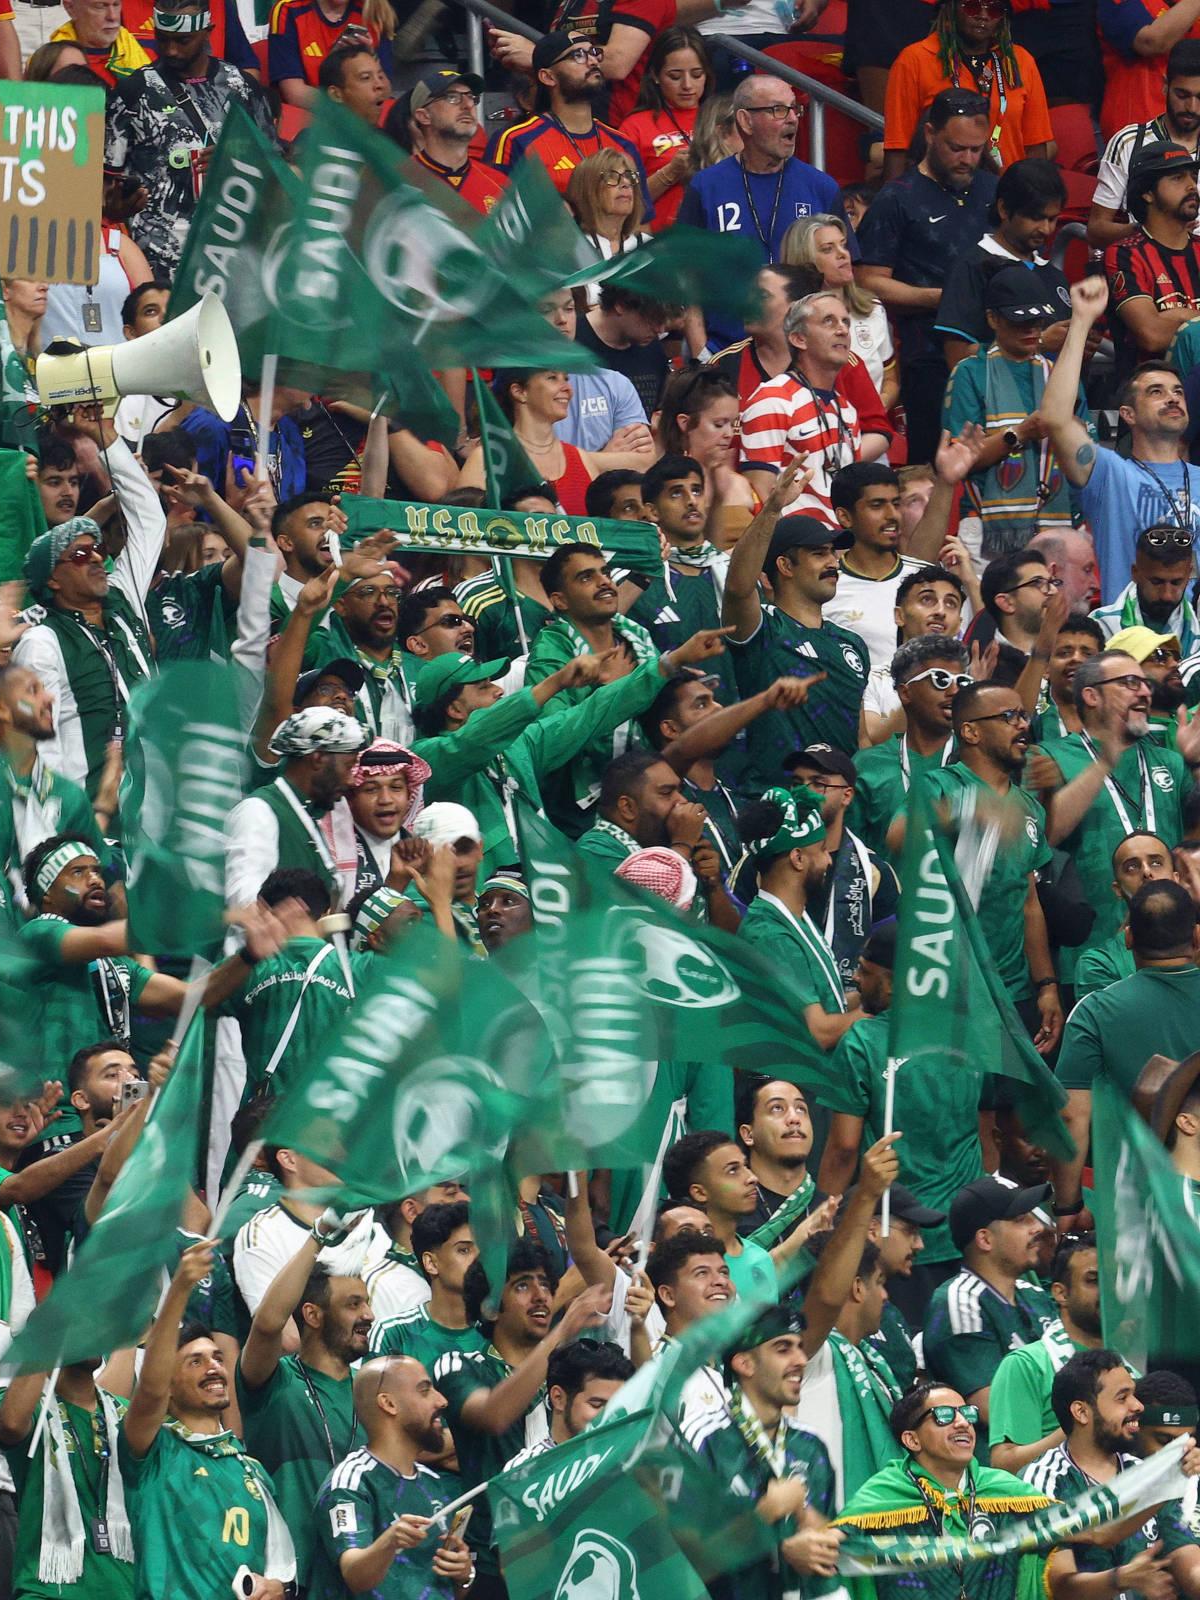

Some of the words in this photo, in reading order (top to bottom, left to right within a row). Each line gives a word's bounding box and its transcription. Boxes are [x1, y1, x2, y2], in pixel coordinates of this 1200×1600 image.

[4, 105, 77, 151] THIS
[194, 158, 264, 300] SAUDI
[717, 202, 741, 233] 12
[522, 1445, 614, 1521] SAUDI
